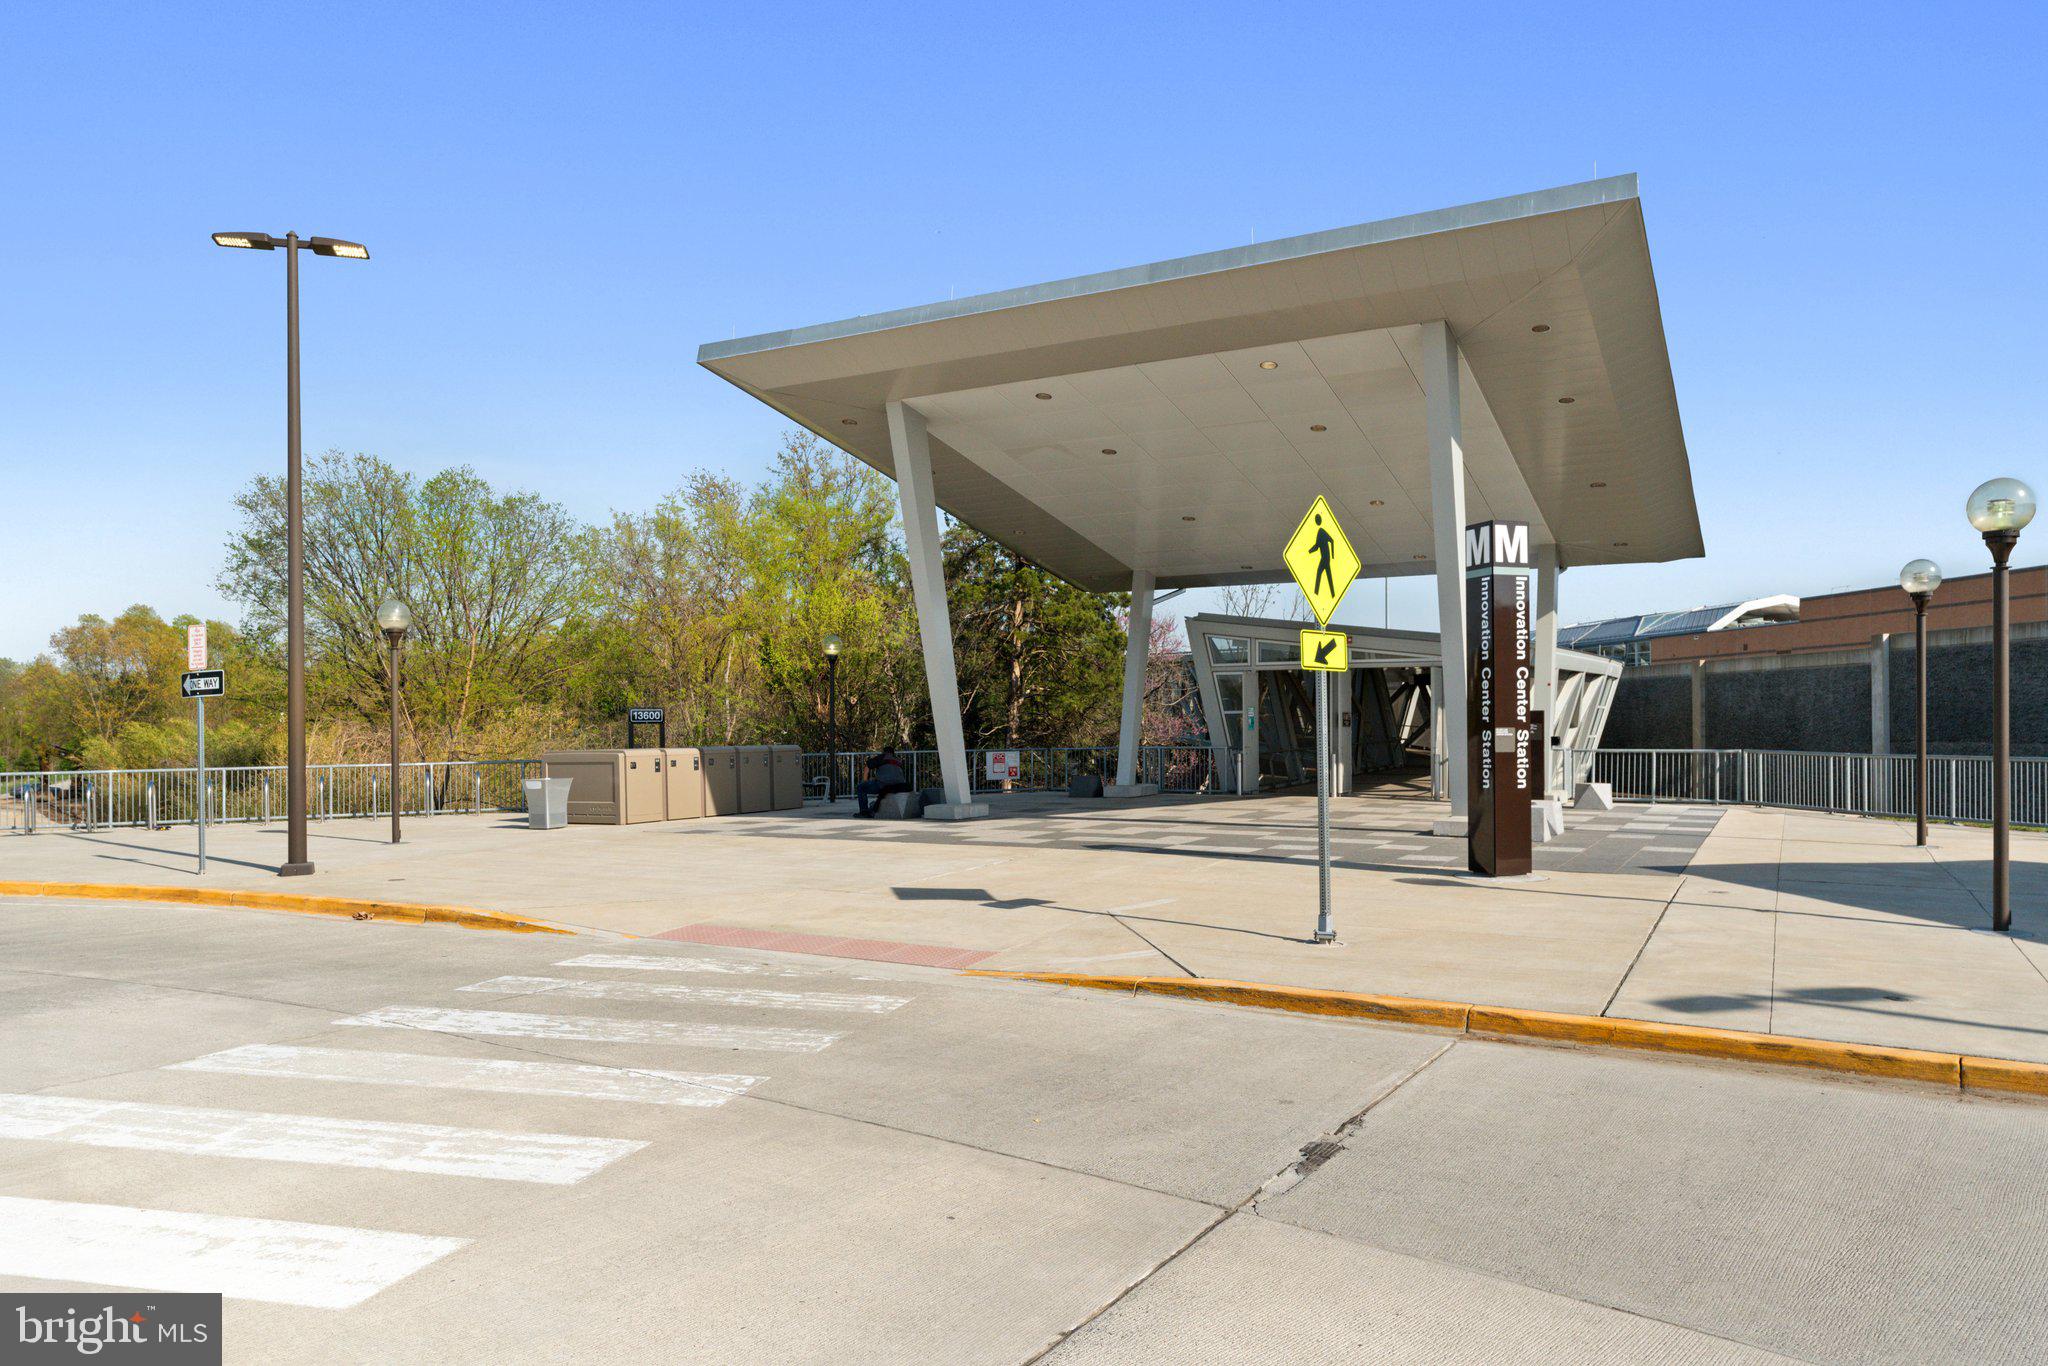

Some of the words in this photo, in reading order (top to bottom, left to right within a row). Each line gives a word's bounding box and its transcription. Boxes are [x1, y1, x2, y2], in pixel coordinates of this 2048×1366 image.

[1466, 525, 1491, 568] M
[1494, 524, 1529, 564] M
[1481, 576, 1491, 660] Innovation
[1515, 576, 1528, 660] Innovation
[190, 679, 202, 690] ONE
[203, 678, 218, 689] WAY
[1481, 666, 1492, 723] Center
[1516, 666, 1529, 723] Center
[633, 711, 661, 720] 13600
[1482, 730, 1492, 789] Station
[1516, 729, 1530, 789] Station
